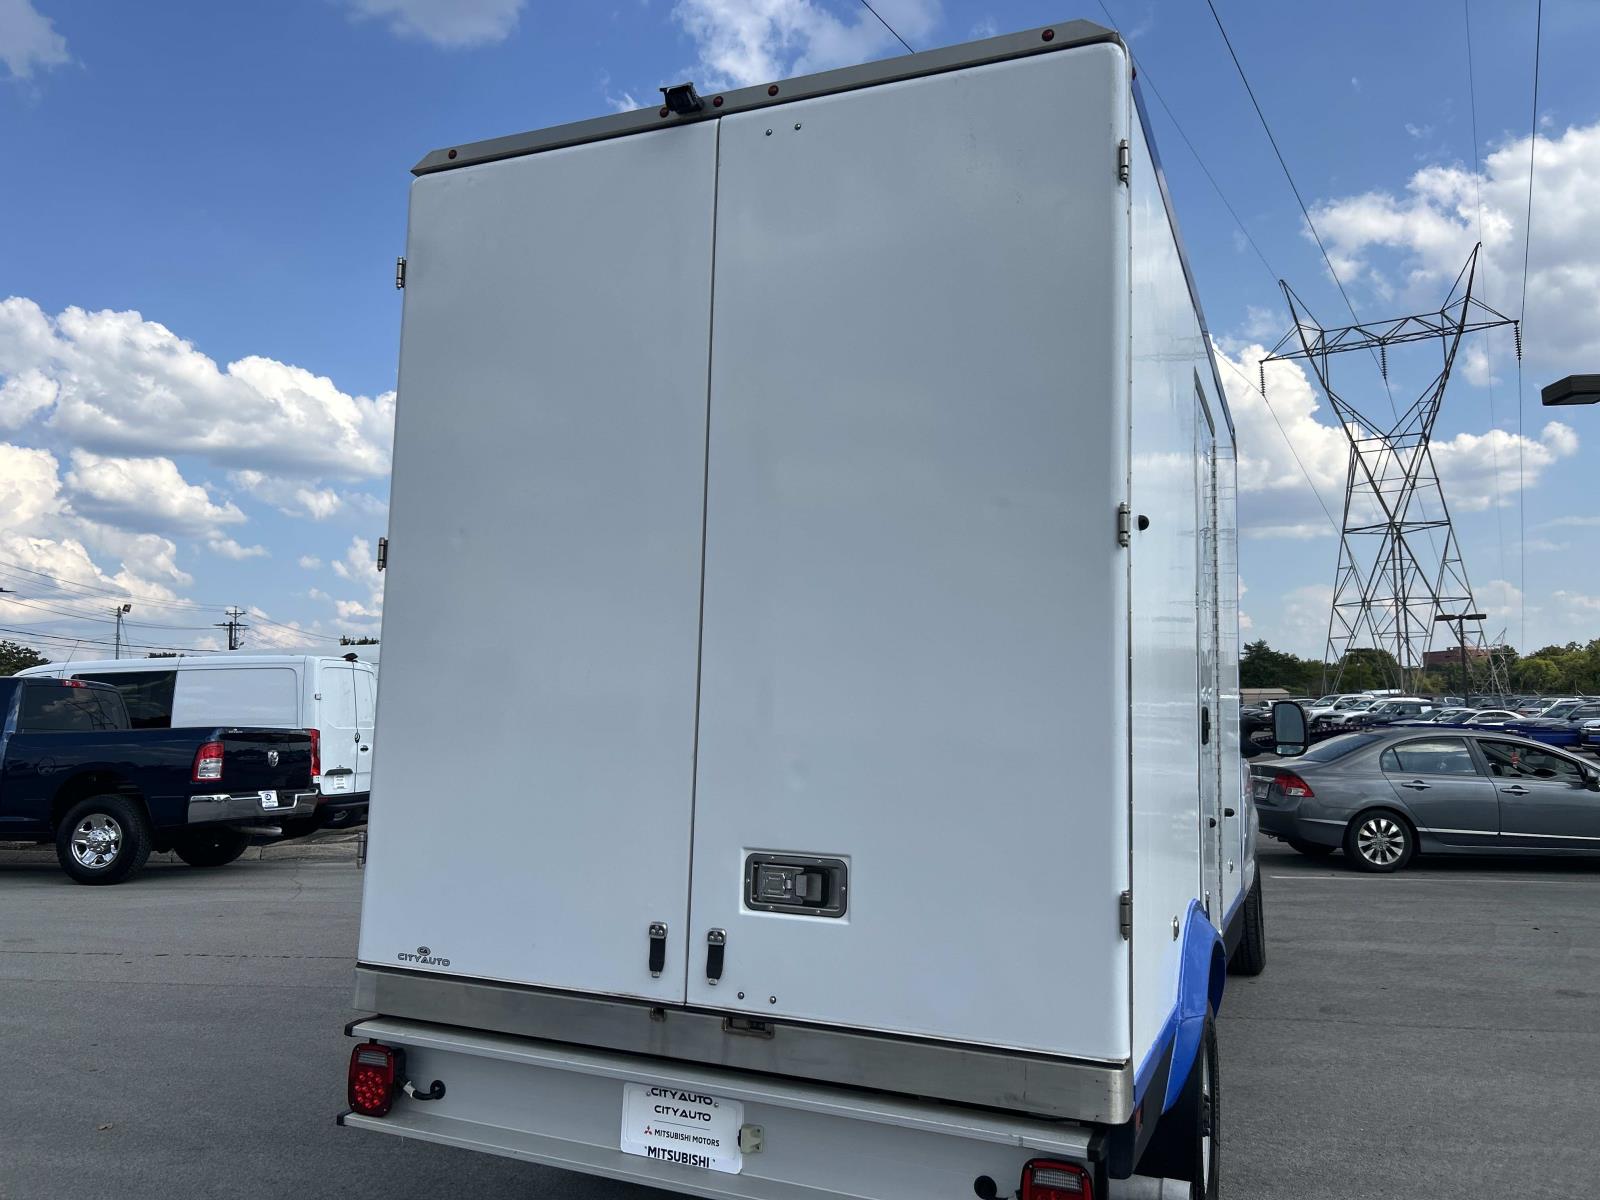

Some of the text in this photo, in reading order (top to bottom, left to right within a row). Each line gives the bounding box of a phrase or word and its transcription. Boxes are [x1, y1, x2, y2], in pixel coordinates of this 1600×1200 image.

[398, 953, 450, 967] CITYAUTO
[650, 1087, 713, 1106] CITYAUTO
[654, 1105, 711, 1122] CITYAUTO
[654, 1129, 720, 1147] MITSUBISHI MOTORS
[647, 1146, 709, 1168] MITSUBISHI
